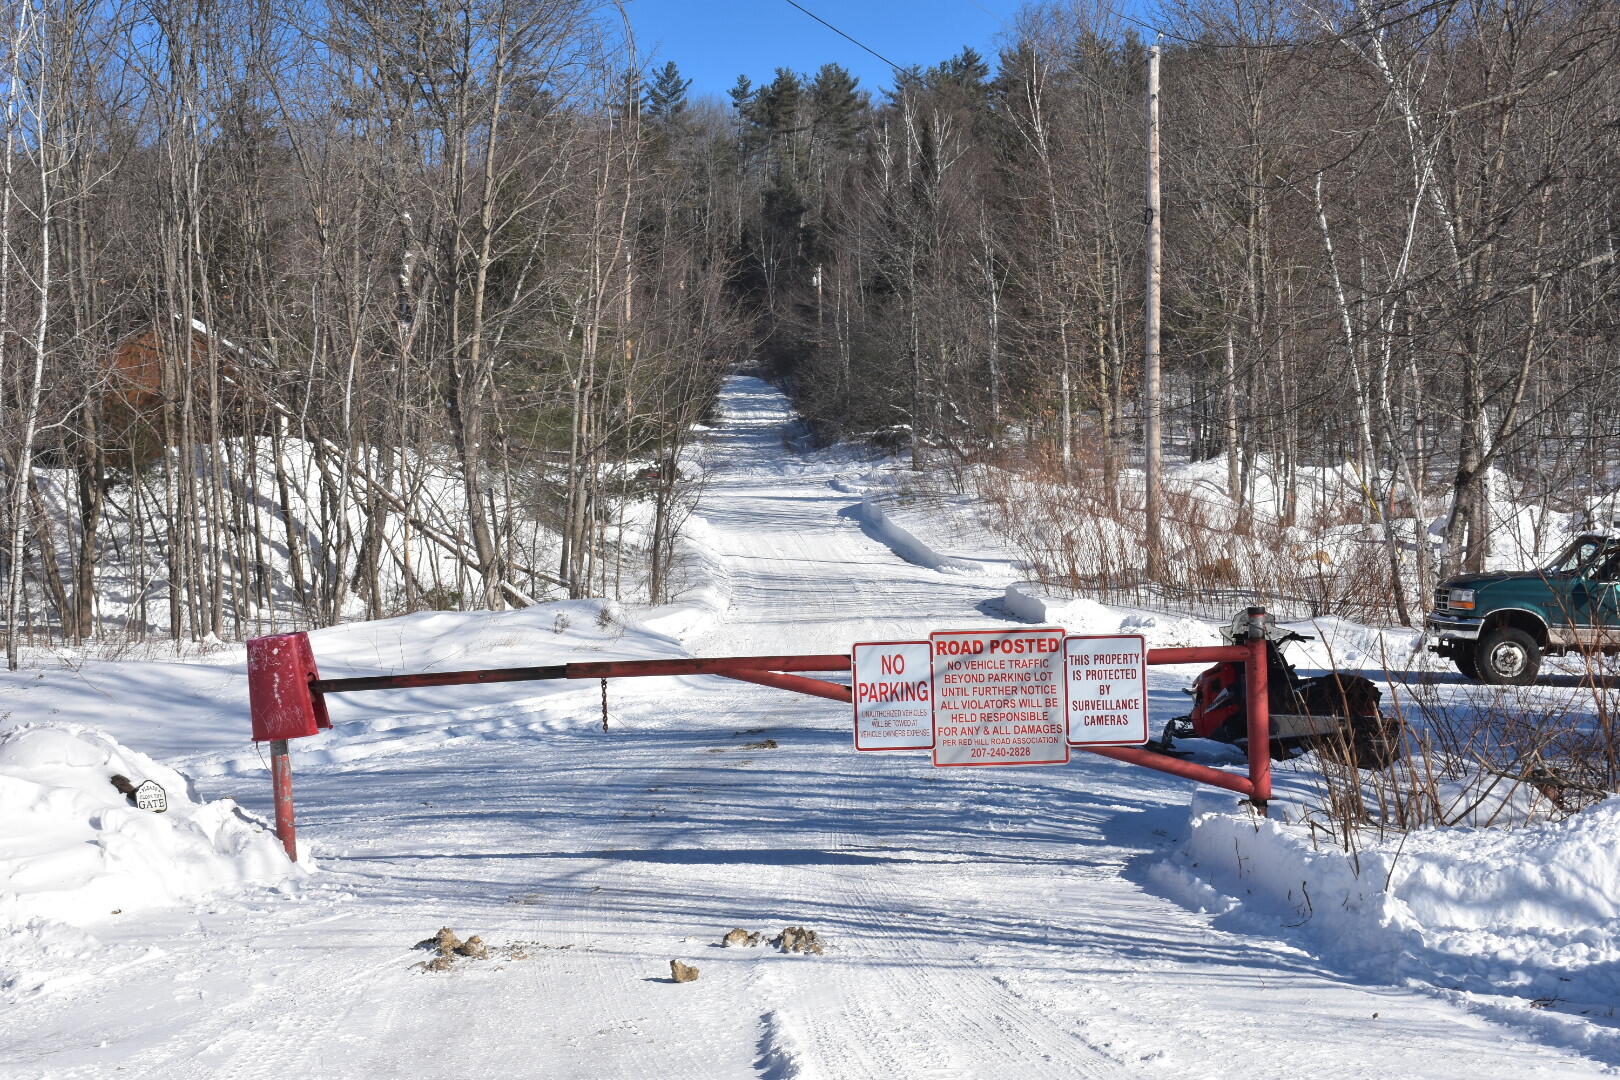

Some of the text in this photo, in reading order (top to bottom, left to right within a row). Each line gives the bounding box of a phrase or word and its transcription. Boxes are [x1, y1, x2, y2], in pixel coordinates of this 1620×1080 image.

[936, 638, 1059, 655] ROAD POSTED
[881, 654, 905, 675] NO
[947, 659, 1049, 670] NO VEHICLE TRAFFIC
[1069, 653, 1140, 666] THIS PROPERTY
[944, 671, 1053, 684] BEYOND PARKING LOT
[1072, 669, 1137, 680] IS PROTECTED
[858, 680, 929, 703] PARKING
[941, 684, 1057, 697] UNTIL FURTHER NOTICE
[1099, 684, 1111, 695] BY
[940, 698, 1058, 710] ALL VIOLATORS WILL BE
[1072, 699, 1140, 711] SURVEILLANCE
[861, 708, 928, 718] UNAUTHORIZED VEHICLES
[951, 711, 1049, 723] HELD RESPONSIBLE
[871, 720, 884, 728] WILL
[892, 719, 911, 727] TOWED
[1084, 714, 1128, 726] CAMERAS
[861, 730, 882, 738] VEHICLE
[937, 724, 1063, 736] FOR ANY & ALL DAMAGES
[958, 738, 972, 746] RED
[974, 738, 989, 746] HILL
[991, 737, 1010, 745] ROAD
[1012, 736, 1059, 744] ASSOCIATION
[971, 747, 1031, 757] 207-240-2828
[138, 799, 164, 809] GATE
